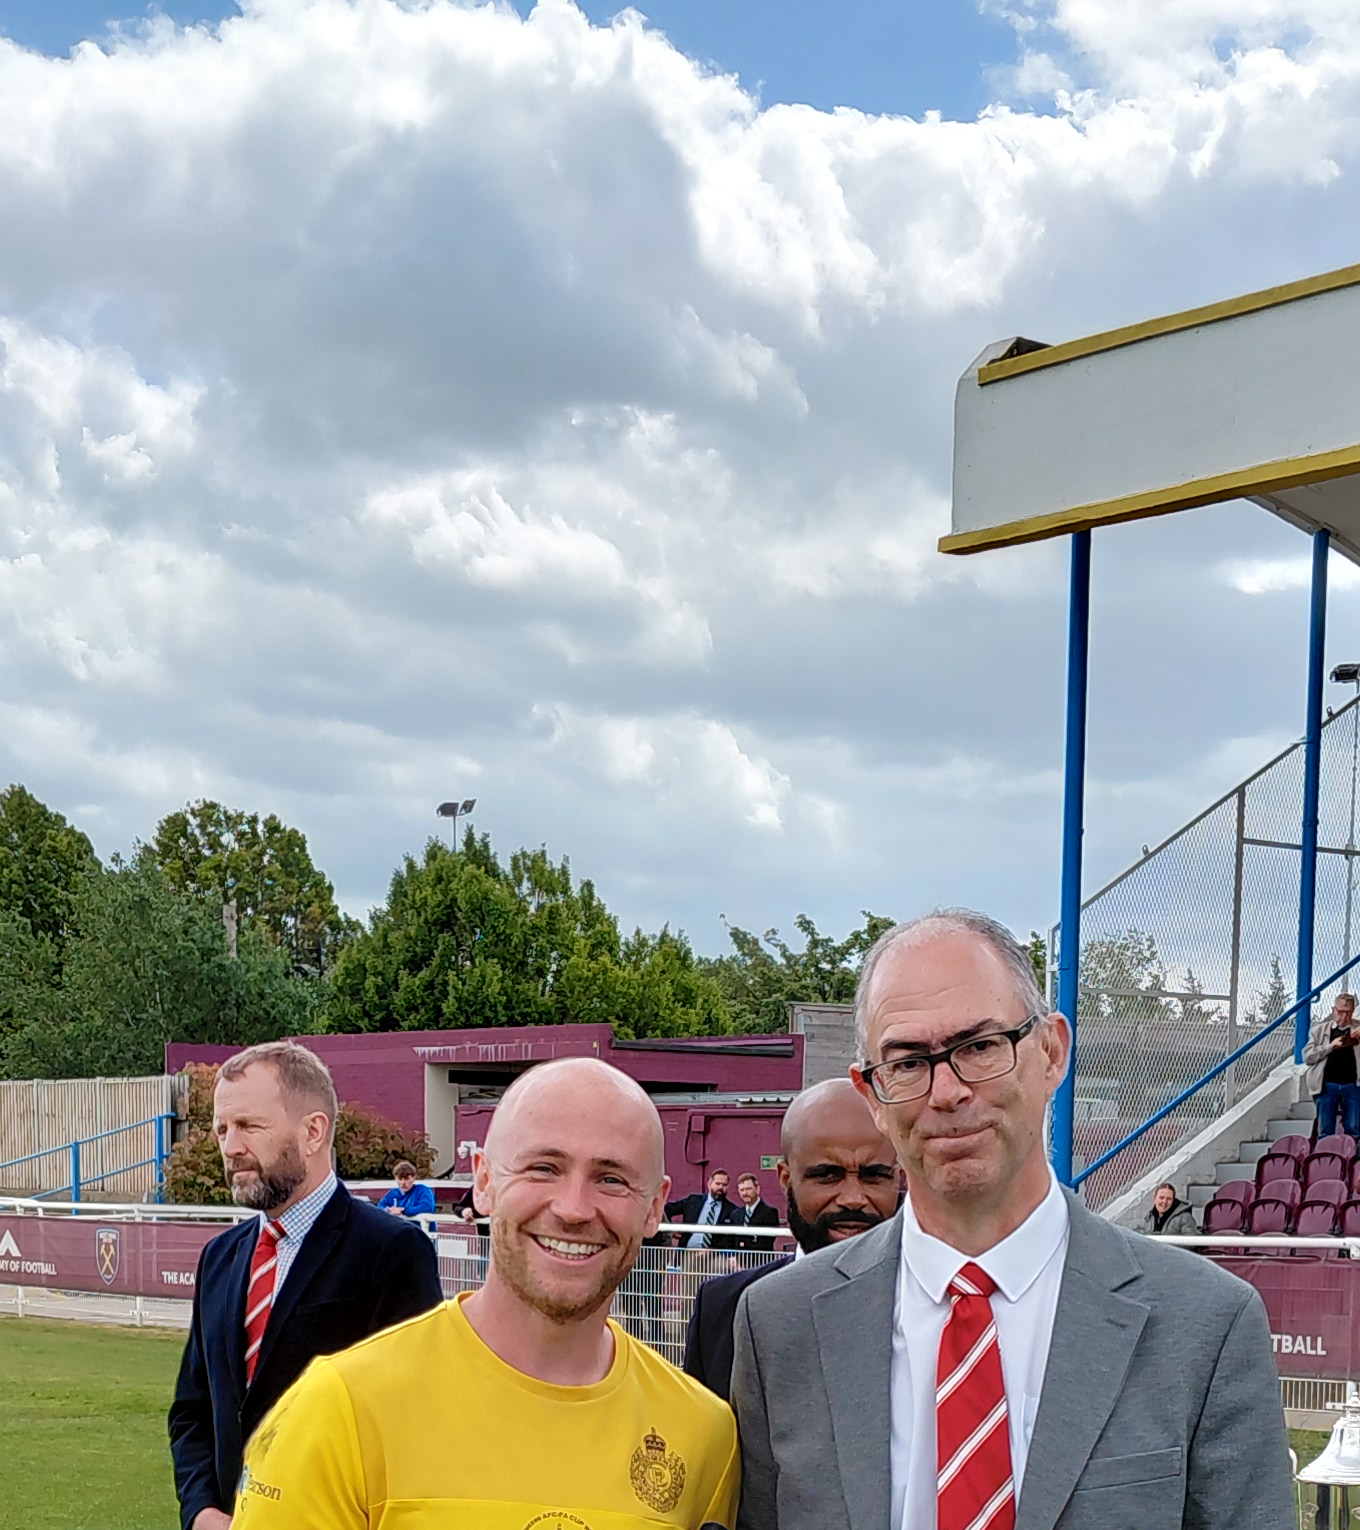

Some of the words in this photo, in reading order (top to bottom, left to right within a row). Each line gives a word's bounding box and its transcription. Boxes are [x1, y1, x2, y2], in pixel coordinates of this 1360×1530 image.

[9, 1260, 20, 1273] OF
[21, 1261, 57, 1276] FOOTBALL
[162, 1271, 178, 1284] THE
[569, 1515, 584, 1526] CUP
